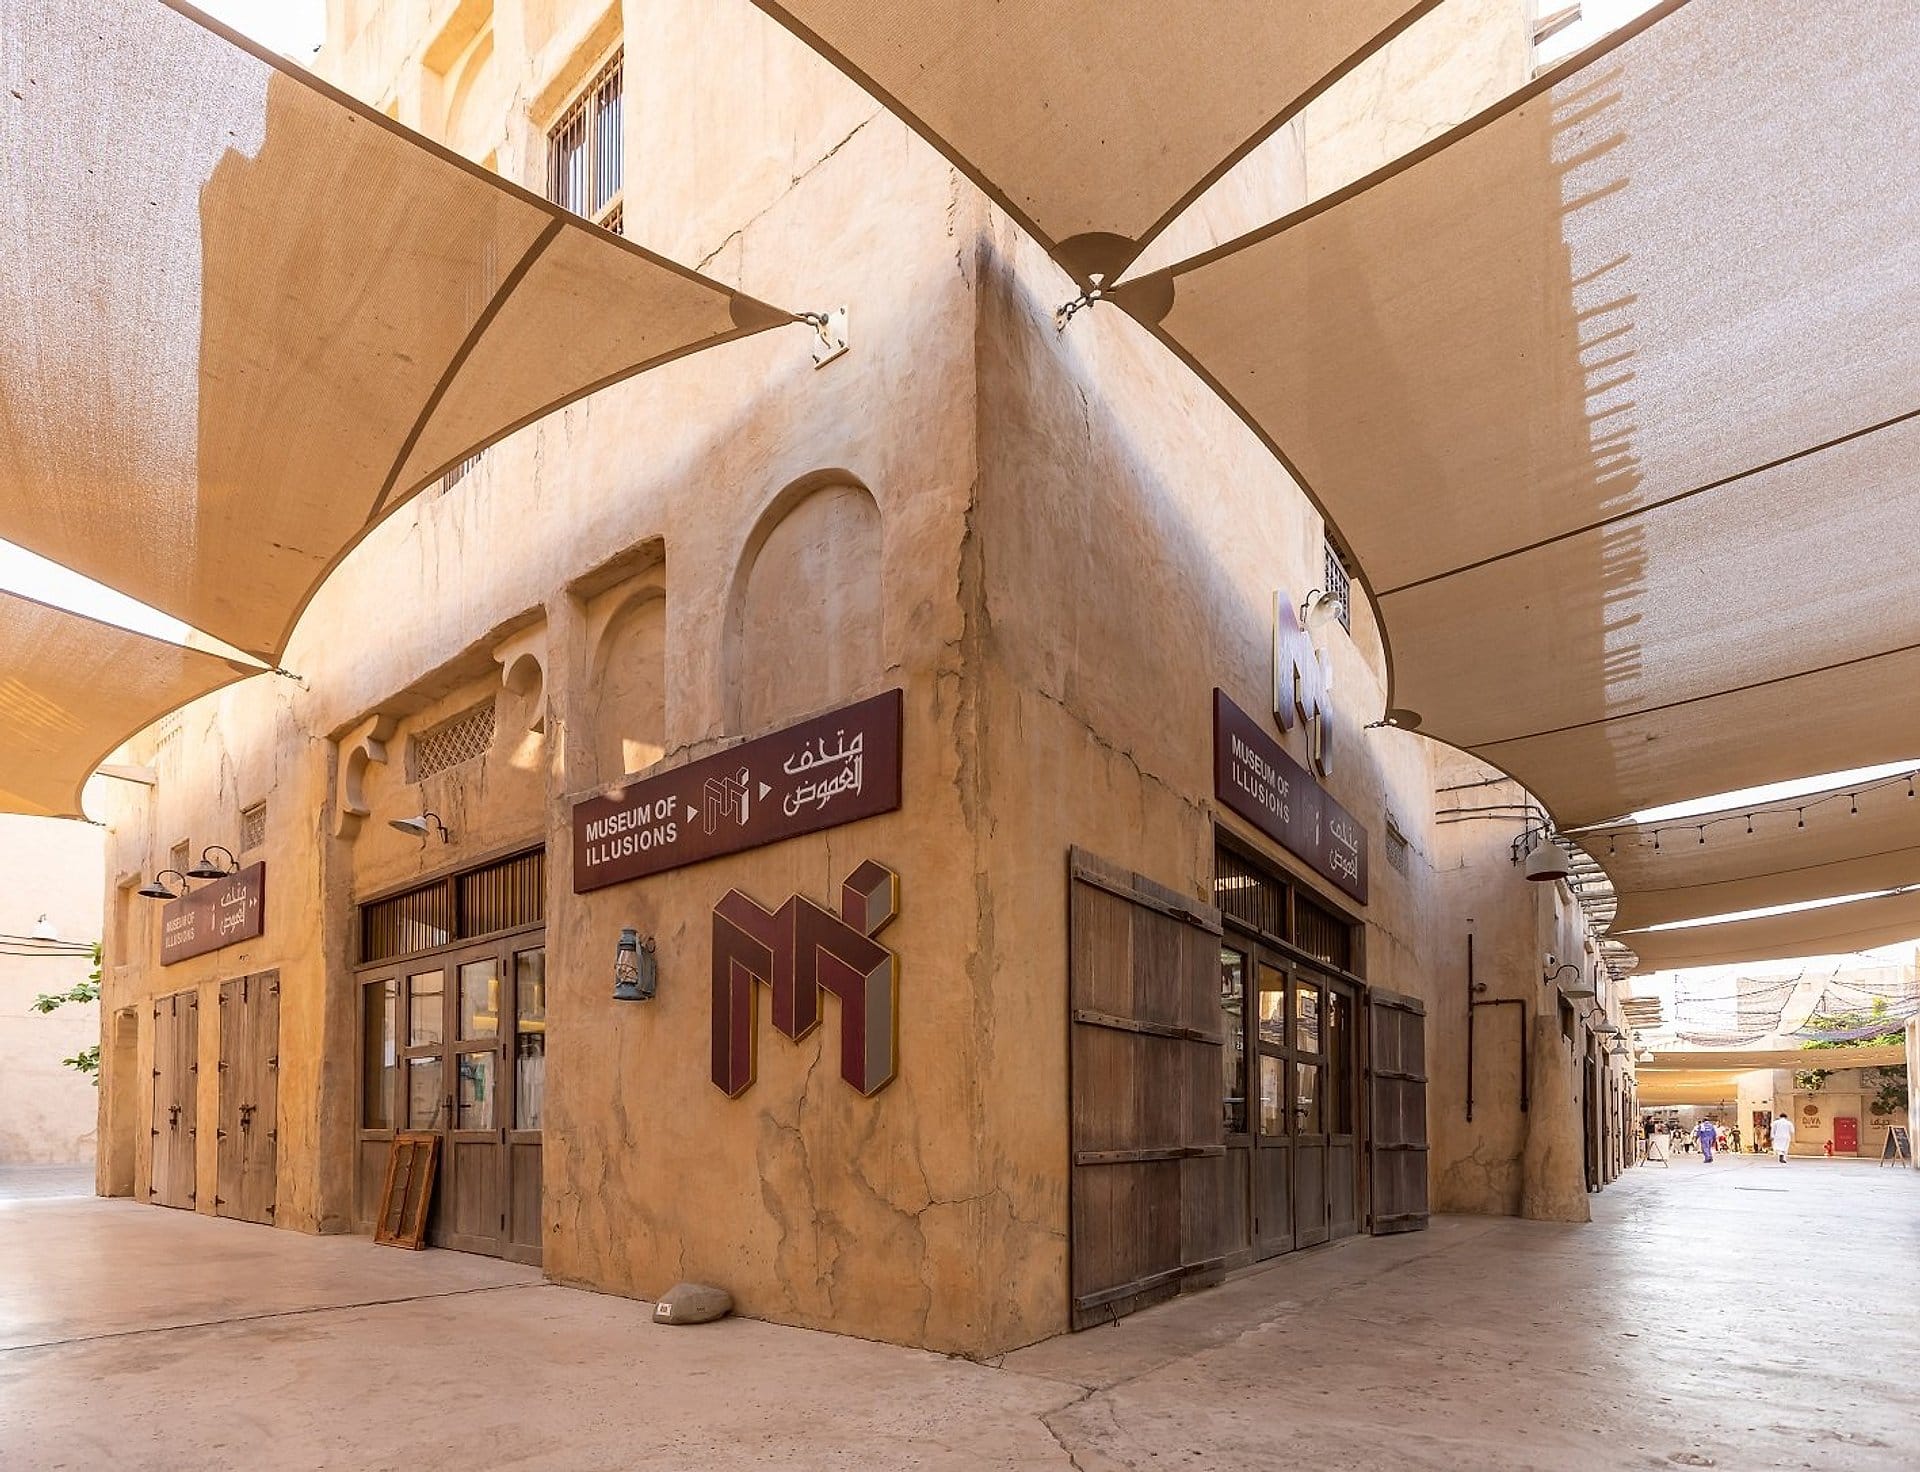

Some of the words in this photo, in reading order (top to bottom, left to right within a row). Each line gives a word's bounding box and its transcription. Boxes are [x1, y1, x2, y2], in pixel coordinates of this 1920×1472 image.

[783, 755, 863, 817] الغموض
[1232, 734, 1275, 787] MUSEUM
[1277, 775, 1290, 798] OF
[1232, 761, 1290, 824] ILLUSIONS
[586, 803, 651, 843] MUSEUM
[655, 795, 678, 824] OF
[586, 822, 677, 867] ILLUSIONS
[165, 927, 195, 949] ILLUSIONS
[166, 914, 187, 933] MUSEUM
